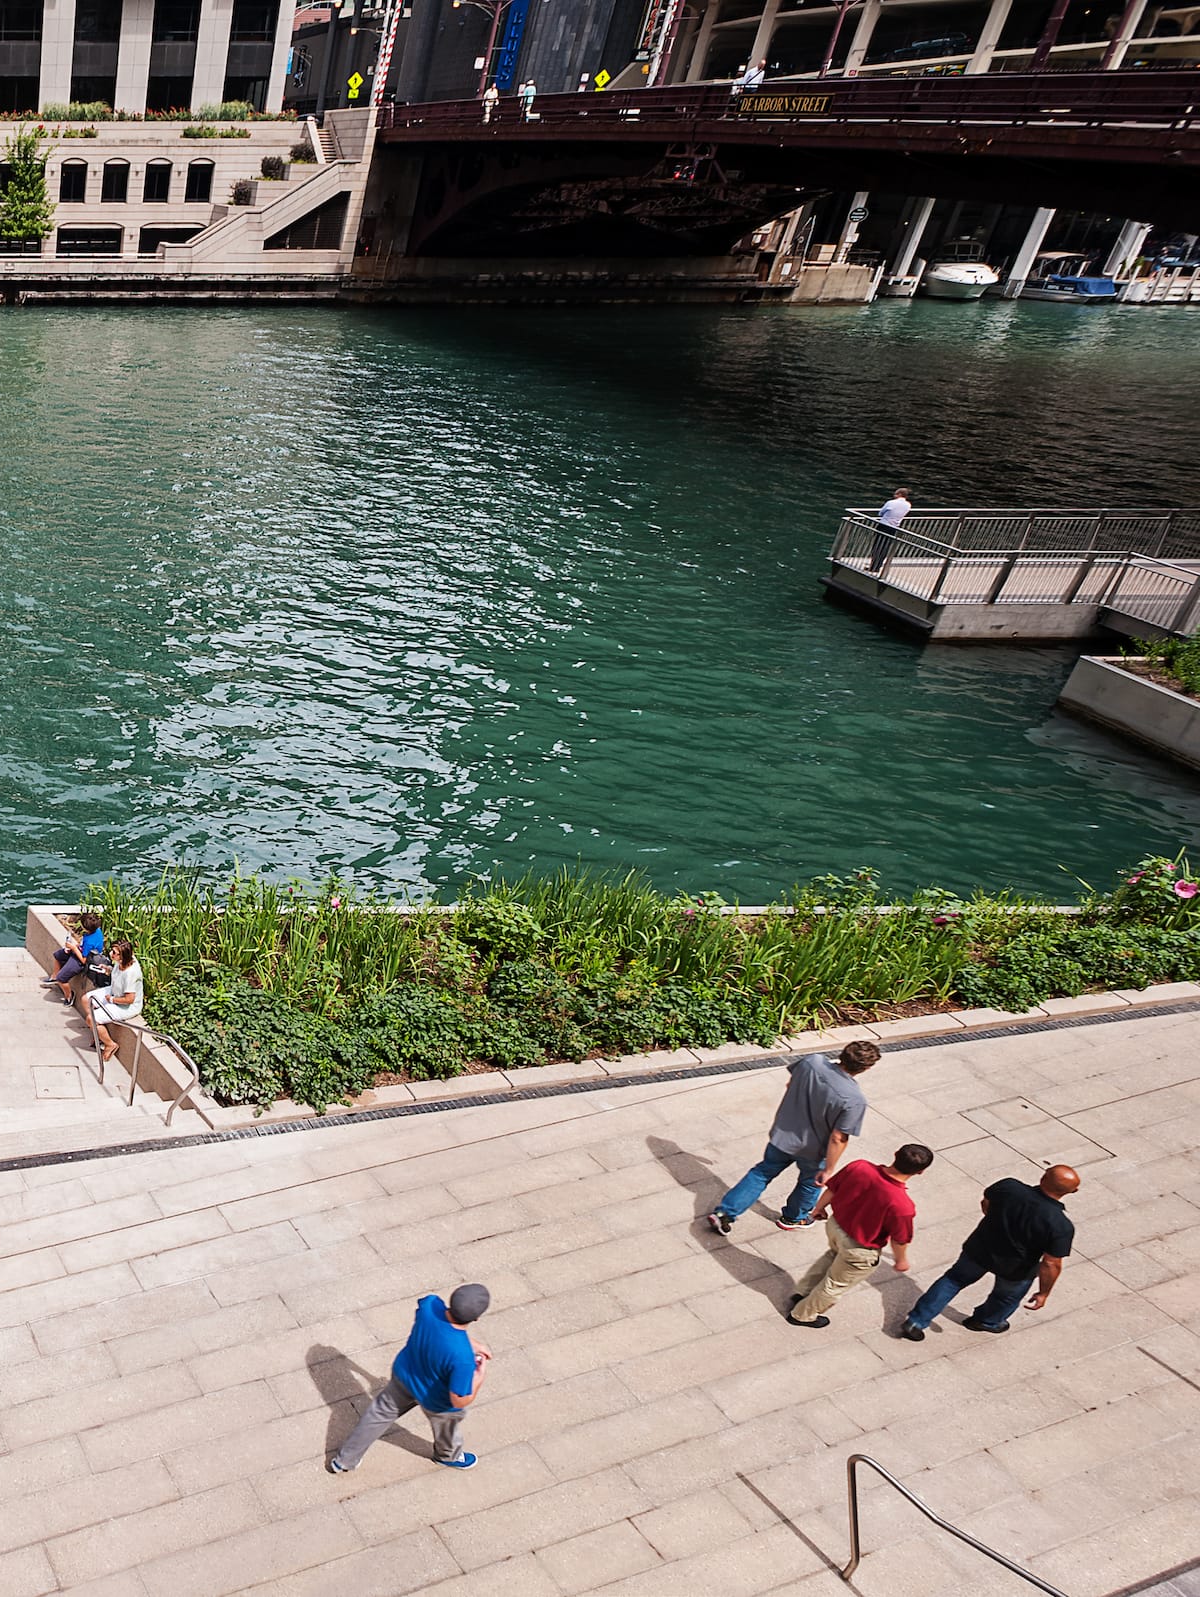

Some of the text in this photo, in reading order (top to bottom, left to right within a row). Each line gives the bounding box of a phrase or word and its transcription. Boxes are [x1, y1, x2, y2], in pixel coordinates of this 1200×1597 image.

[500, 11, 524, 80] BLUES
[740, 96, 829, 112] DEARBORN STREET
